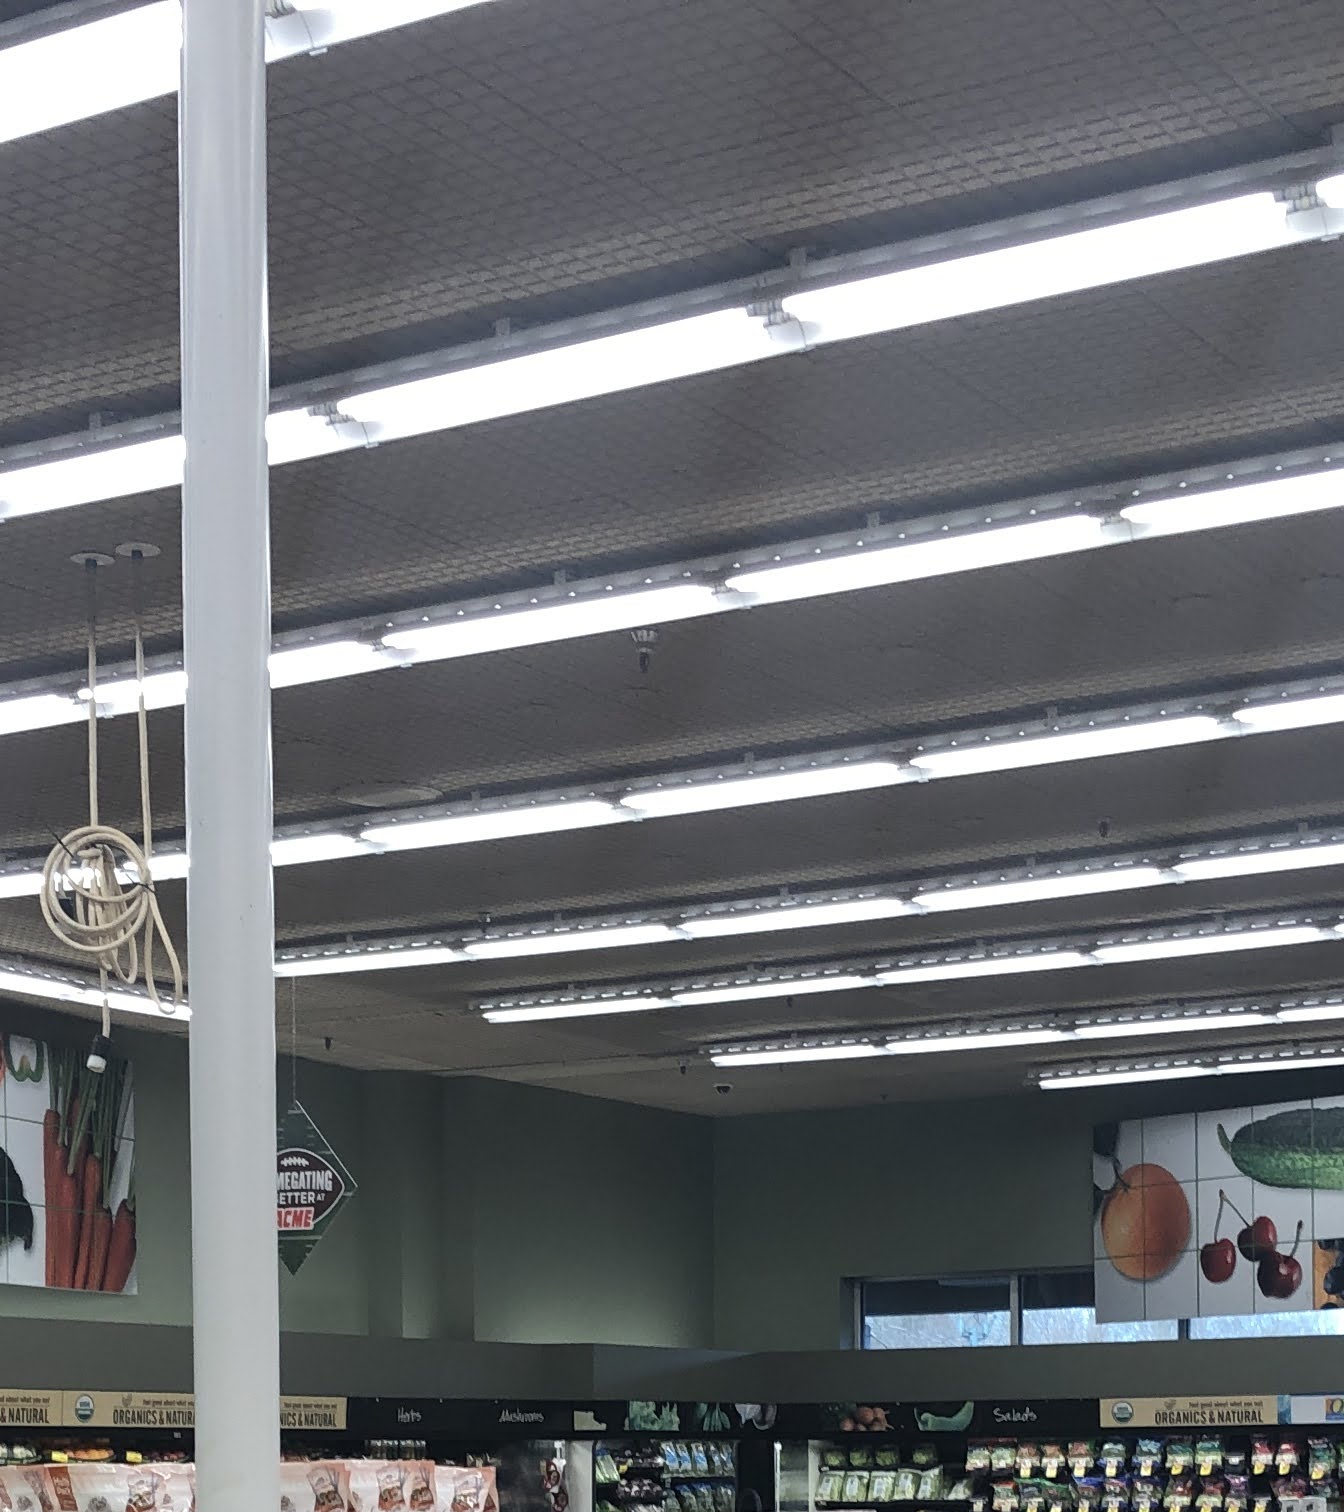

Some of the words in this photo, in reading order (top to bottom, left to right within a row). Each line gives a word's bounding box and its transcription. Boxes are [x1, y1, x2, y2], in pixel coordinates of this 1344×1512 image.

[277, 1170, 333, 1191] MEGATING
[277, 1191, 315, 1204] ETTER
[317, 1194, 325, 1202] AT
[0, 1407, 7, 1423] &
[8, 1407, 50, 1424] NATURAL
[113, 1409, 157, 1425] ORGANICS
[158, 1410, 164, 1425] &
[166, 1410, 195, 1426] NATUR
[280, 1412, 296, 1427] NICS
[298, 1413, 304, 1426] &
[304, 1412, 337, 1428] NATURAL
[993, 1407, 1038, 1424] Salads
[1154, 1410, 1205, 1425] ORGANICS
[1207, 1410, 1216, 1424] &
[1218, 1409, 1263, 1424] NATURAL
